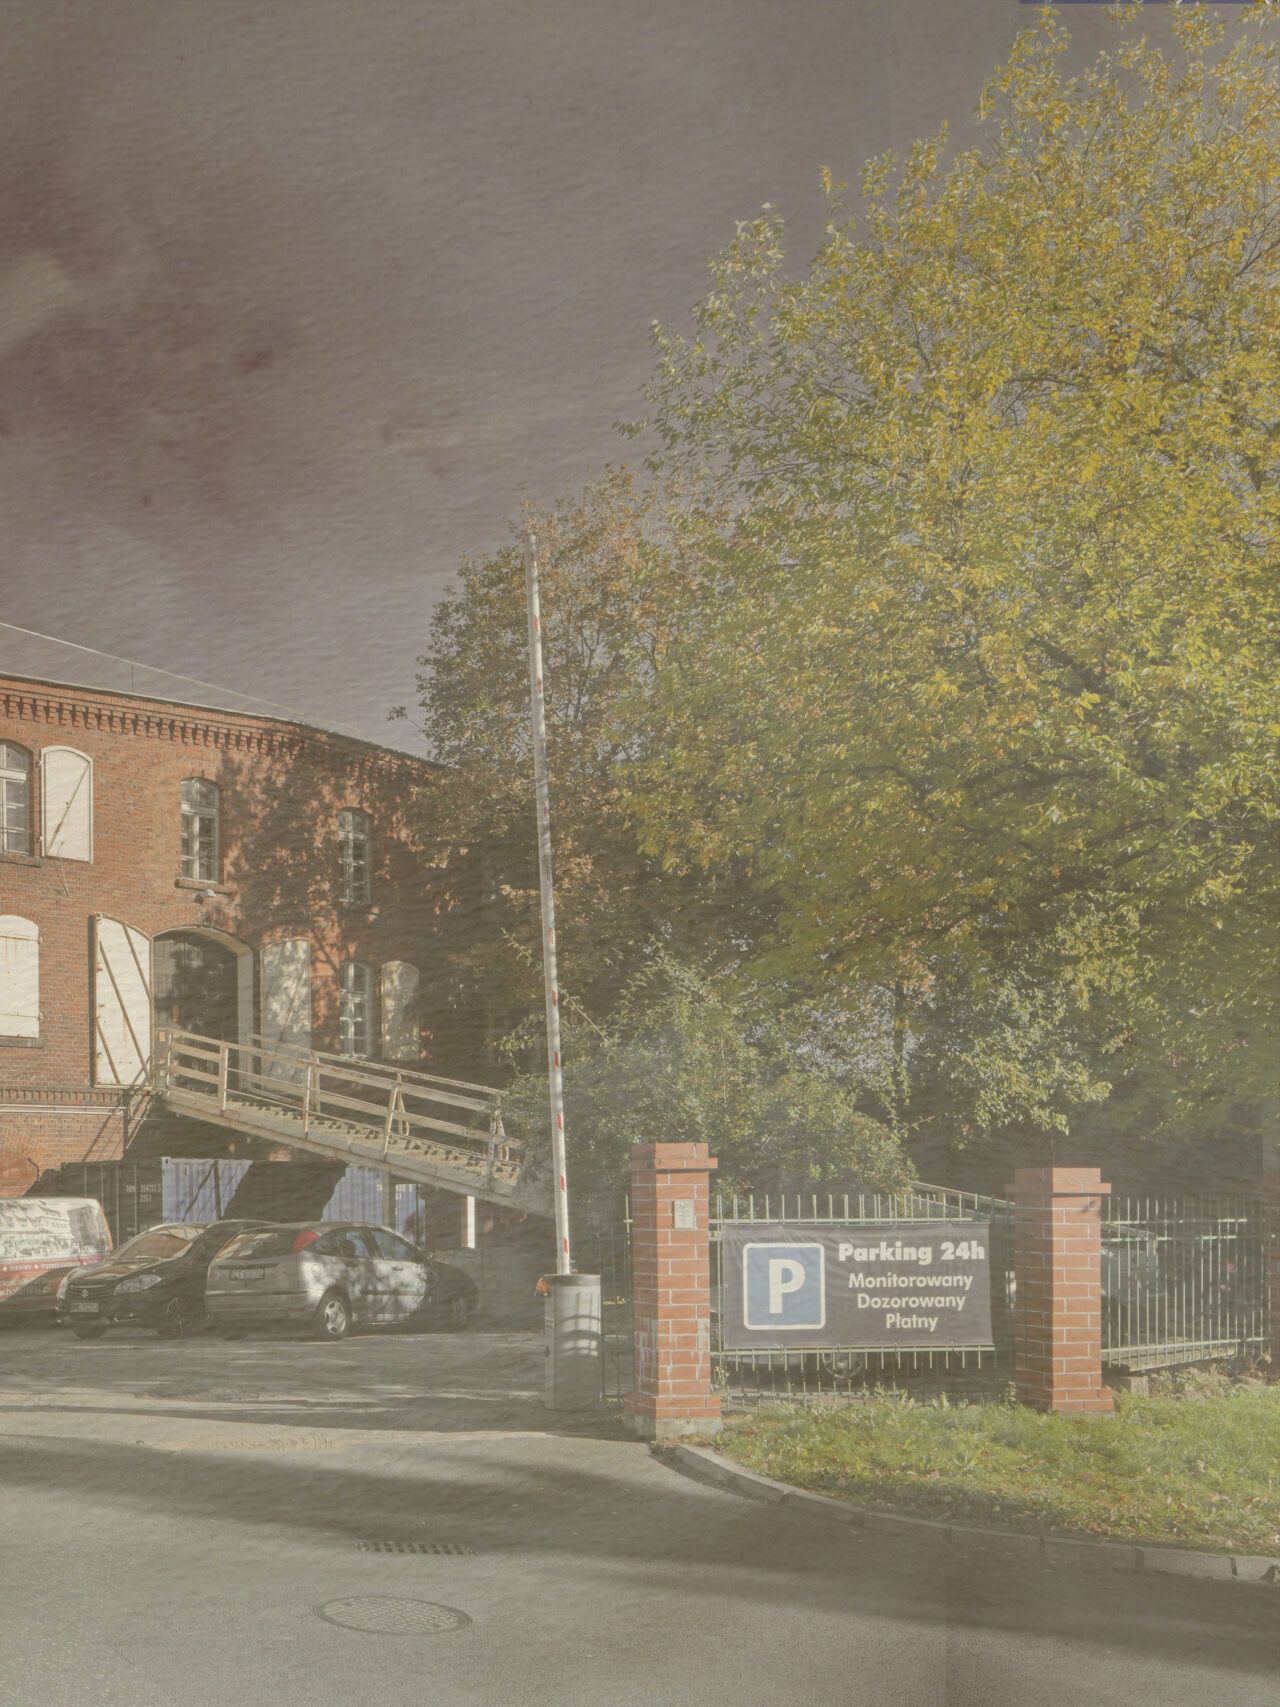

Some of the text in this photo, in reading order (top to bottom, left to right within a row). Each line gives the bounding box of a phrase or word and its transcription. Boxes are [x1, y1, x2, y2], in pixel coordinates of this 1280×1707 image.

[838, 1241, 986, 1265] Parking 24h
[768, 1259, 806, 1314] P
[848, 1273, 974, 1291] Monitorowany
[857, 1294, 966, 1310] Dozorowany
[886, 1313, 939, 1332] Płatny
